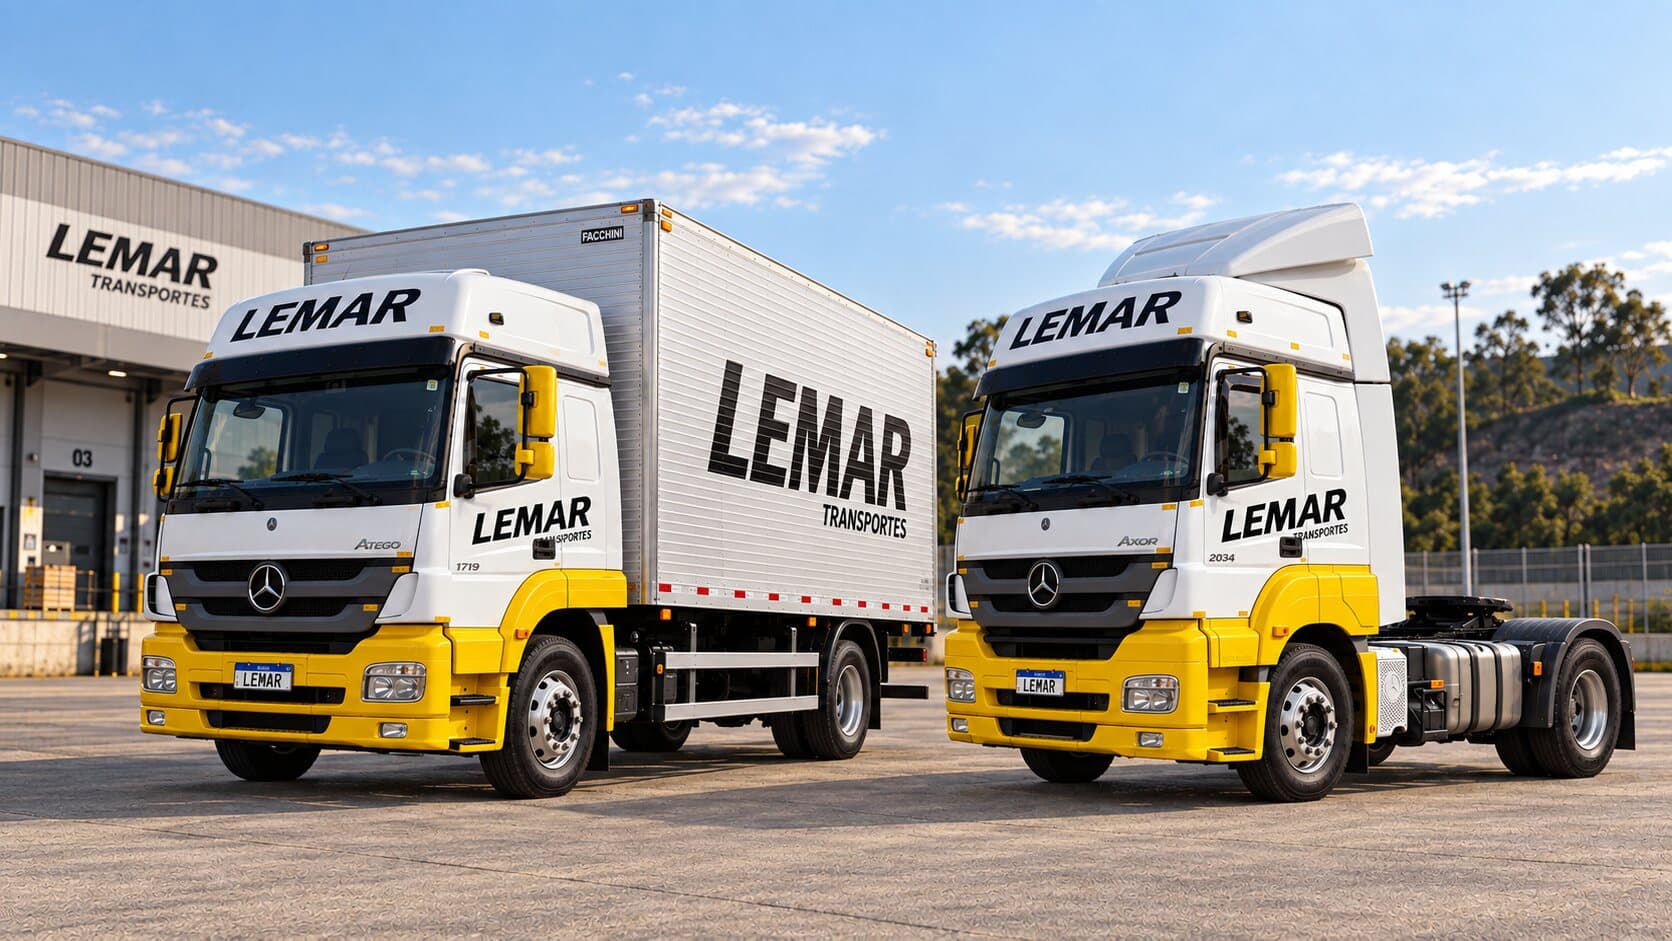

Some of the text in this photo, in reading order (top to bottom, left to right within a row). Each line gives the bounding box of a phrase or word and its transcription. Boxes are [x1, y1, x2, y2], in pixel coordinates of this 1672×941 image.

[582, 228, 623, 242] FACCHINI
[46, 223, 218, 290] LEMAR
[91, 274, 211, 310] TRANSPORTES
[230, 288, 422, 343] LEMAR
[1009, 290, 1182, 351] LEMAR
[707, 359, 912, 512] LEMAR
[72, 448, 93, 468] 03
[471, 496, 592, 545] LEMAR
[822, 503, 907, 539] TRANSPORTES
[1221, 488, 1347, 543] LEMAR
[354, 538, 402, 551] ATEGO
[540, 529, 592, 544] NSPORTES
[1117, 535, 1159, 547] AXOR
[456, 562, 480, 572] 1719
[1208, 553, 1235, 563] 2034
[243, 671, 282, 688] LEMAR
[1023, 678, 1056, 693] LEMAR
